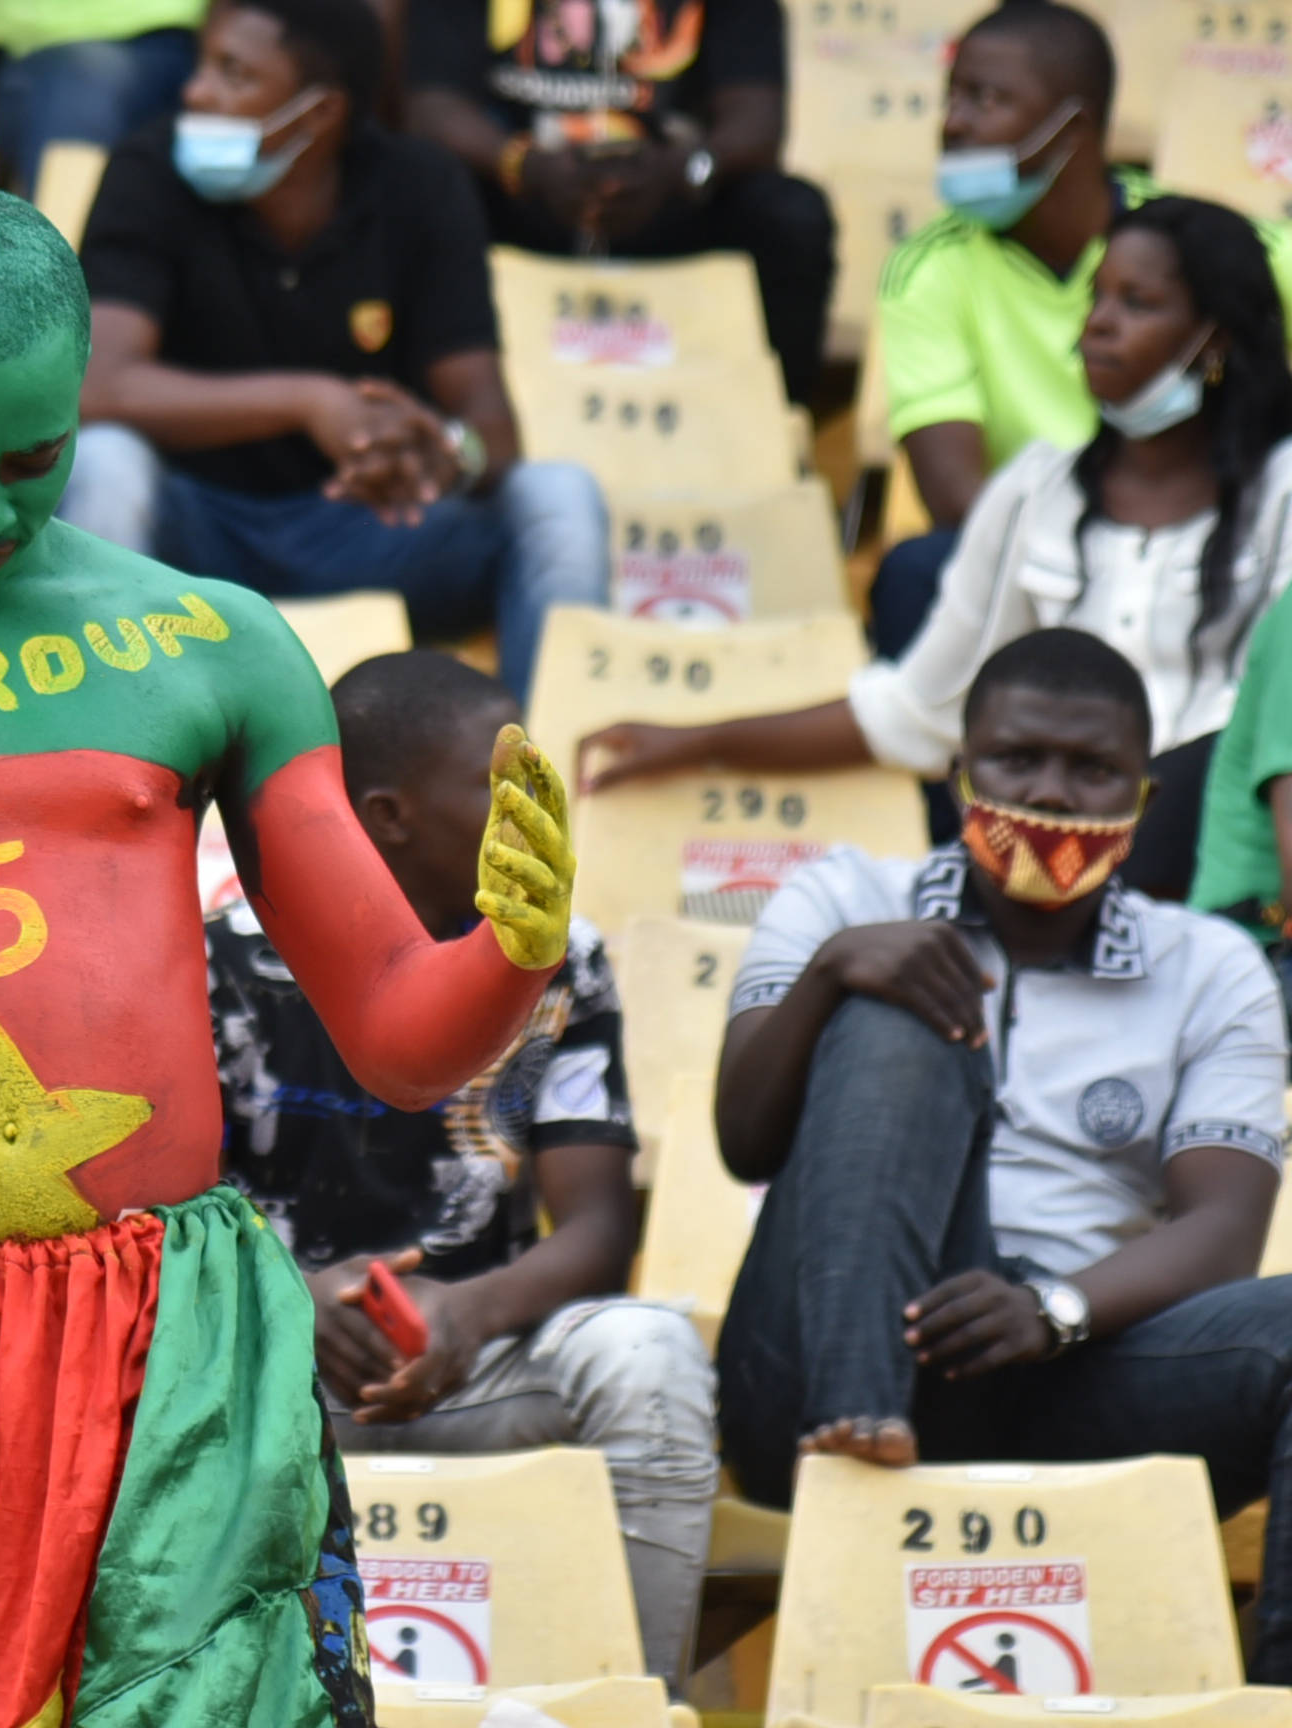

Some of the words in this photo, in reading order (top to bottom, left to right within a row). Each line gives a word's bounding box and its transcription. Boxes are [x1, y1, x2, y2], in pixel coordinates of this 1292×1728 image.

[902, 1506, 1047, 1556] 290
[458, 1563, 486, 1580] TO
[914, 1567, 1043, 1587] FORBIDDEN
[1048, 1564, 1079, 1585] TO
[388, 1580, 485, 1600] HERE
[916, 1588, 973, 1608] SIT
[982, 1585, 1079, 1606] HERE
